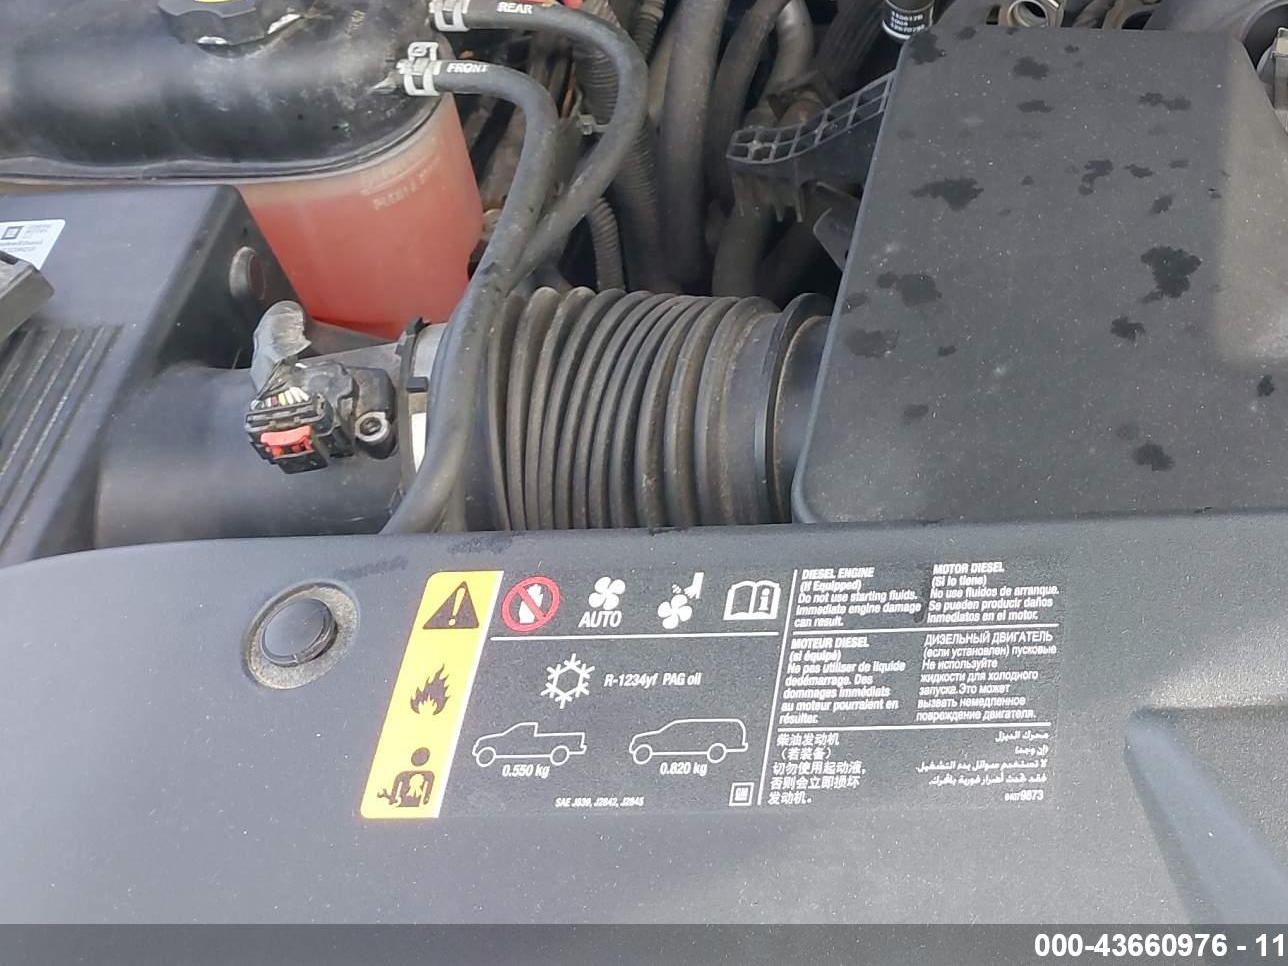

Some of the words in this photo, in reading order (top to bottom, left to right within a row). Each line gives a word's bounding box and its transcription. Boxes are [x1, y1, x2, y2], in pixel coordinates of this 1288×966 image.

[496, 1, 533, 14] REAR
[446, 63, 489, 73] FRONT
[802, 568, 836, 580] DIESEL
[838, 567, 875, 578] ENGINE
[933, 563, 968, 575] MOTOR
[971, 562, 1005, 573] DIESEL
[813, 579, 862, 593] Equipped)
[931, 575, 945, 588] (Si
[959, 574, 987, 587] tiene)
[798, 593, 811, 603] Do
[812, 592, 829, 603] not
[830, 593, 848, 603] use
[850, 591, 887, 604] starting
[889, 589, 918, 601] fluids.
[930, 588, 943, 599] No
[945, 588, 963, 598] use
[965, 586, 998, 598] fluidos
[1000, 586, 1011, 596] de
[1014, 585, 1059, 597] arranque.
[848, 603, 881, 616] engine
[883, 602, 921, 614] damage
[929, 600, 941, 611] Se
[943, 599, 979, 613] pueden
[981, 597, 1022, 611] producir
[1024, 597, 1053, 607] daños
[578, 610, 622, 628] AUTO
[794, 618, 811, 627] can
[814, 616, 844, 626] result.
[982, 612, 994, 621] en
[997, 610, 1005, 621] el
[1008, 610, 1038, 621] motor.
[791, 638, 833, 650] MOTEUR
[835, 636, 869, 648] DIESEL
[924, 631, 990, 647] ДИЗЕЛЬНЫЙ
[992, 631, 1053, 645] ДВИГАТЕЛЬ
[923, 647, 950, 659] (если
[952, 644, 1009, 659] установлен)
[1012, 645, 1057, 657] пусковые
[787, 662, 800, 674] Ne
[802, 663, 821, 676] pas
[822, 662, 857, 673] utiliser
[857, 661, 871, 672] de
[872, 660, 906, 674] liquide
[922, 659, 936, 670] Не
[938, 658, 998, 671] используйте
[604, 673, 659, 689] R-1234yf
[662, 673, 686, 686] PAG
[687, 672, 702, 685] oil
[854, 674, 873, 685] Des
[920, 672, 966, 683] жидкости
[967, 672, 986, 683] для
[988, 671, 1038, 682] холодного
[783, 688, 838, 700] dommages
[781, 702, 794, 712] au
[796, 700, 832, 711] moteur
[833, 699, 884, 713] pourraient
[885, 700, 899, 709] en
[779, 713, 819, 724] résulter.
[777, 733, 839, 746] 柴油发动机
[502, 764, 533, 778] 0.550
[534, 764, 550, 779] kg
[660, 762, 691, 775] 0.820
[693, 761, 708, 776] kg
[555, 798, 571, 807] SAE
